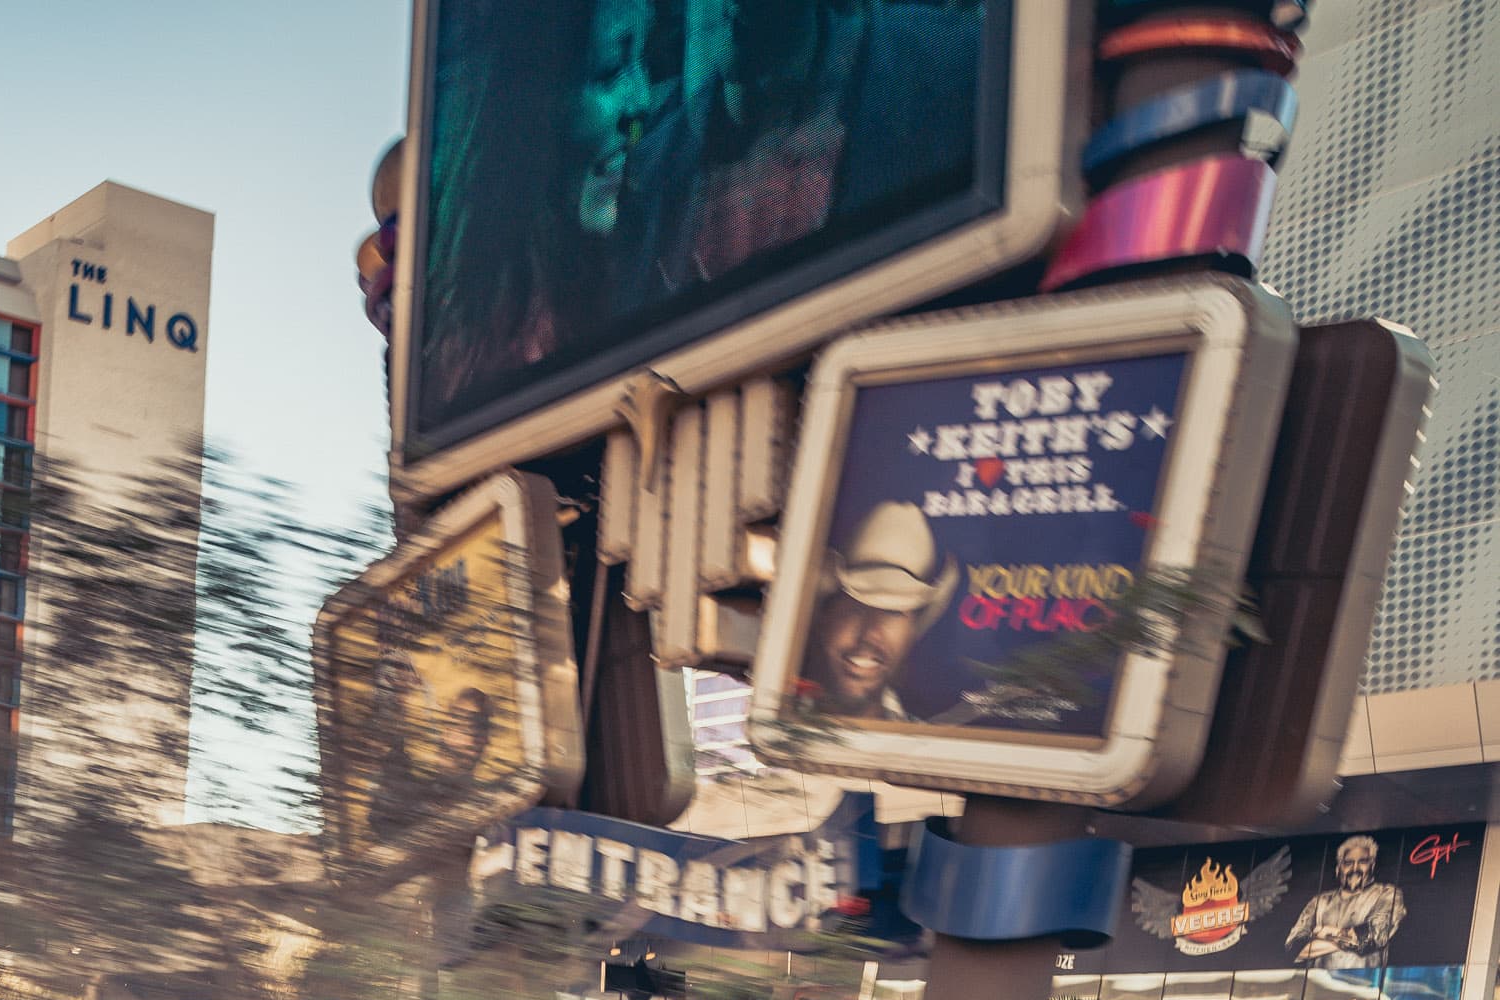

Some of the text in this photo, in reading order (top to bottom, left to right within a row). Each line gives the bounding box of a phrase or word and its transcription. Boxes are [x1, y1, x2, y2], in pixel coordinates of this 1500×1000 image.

[71, 258, 108, 285] THE
[67, 283, 199, 354] LINQ
[971, 371, 1114, 421] TOBY
[934, 410, 1138, 461] KEITH'S
[1004, 454, 1094, 486] THIS
[966, 563, 1134, 600] YOUR KIND
[959, 594, 1118, 633] OF PLAC
[514, 826, 840, 934] ENTRANCE
[1175, 904, 1246, 934] VEGAS
